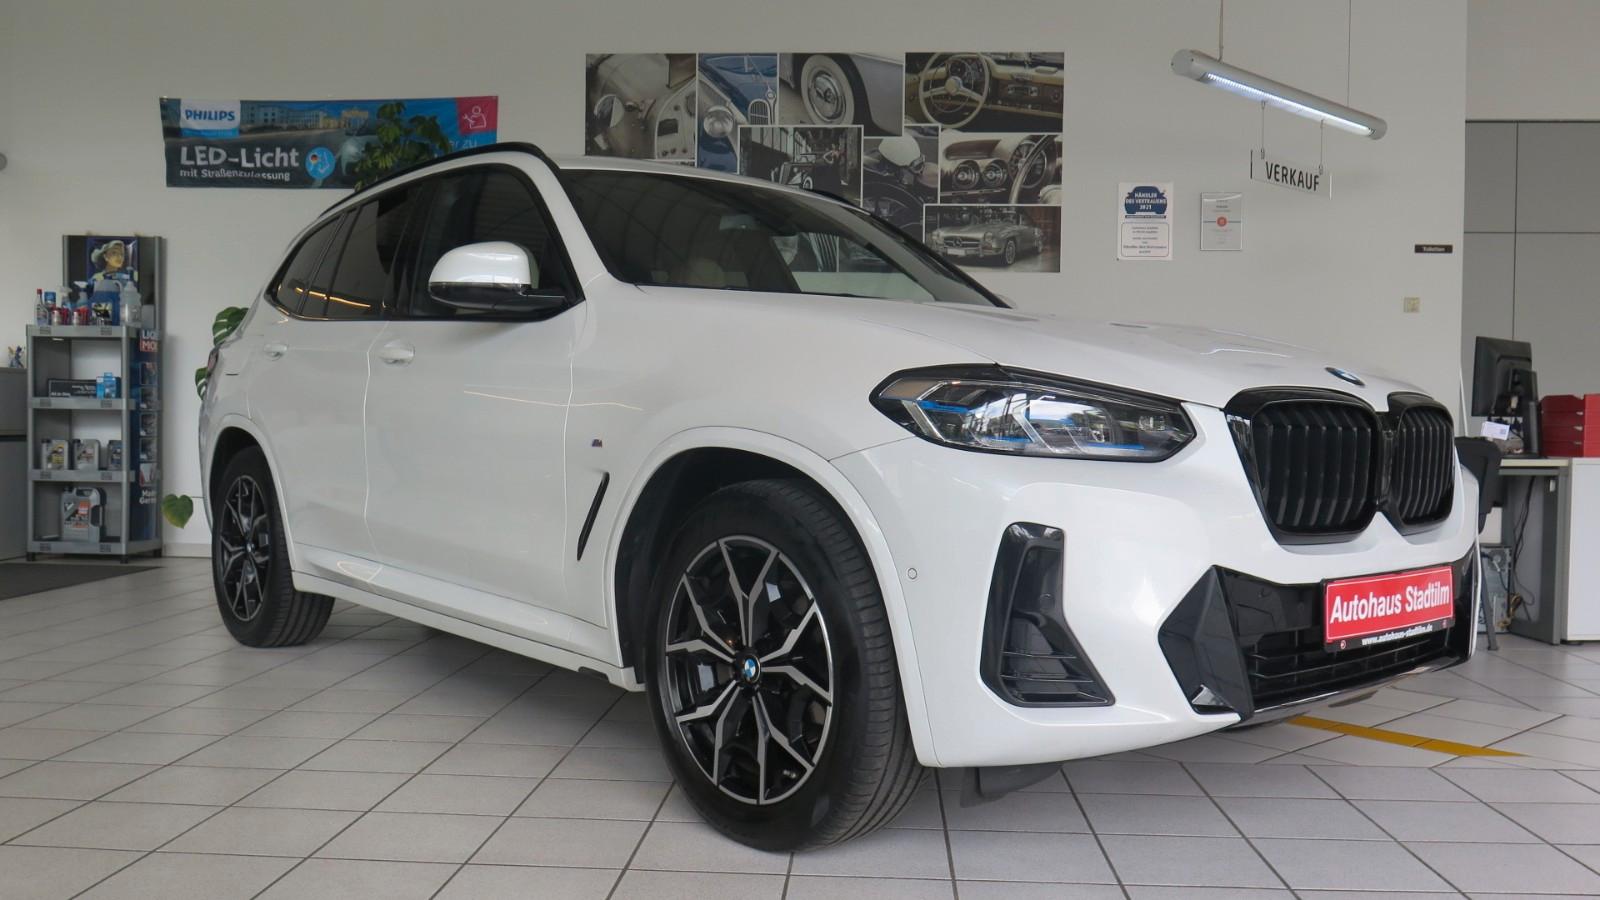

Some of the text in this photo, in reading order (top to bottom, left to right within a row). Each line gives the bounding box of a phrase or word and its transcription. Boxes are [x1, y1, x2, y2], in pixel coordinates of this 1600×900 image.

[184, 109, 236, 121] PHILIPS
[180, 146, 300, 168] LED-Licht
[180, 168, 291, 181] mit Straßenzulassung
[1265, 161, 1320, 192] VERKAUF
[1330, 581, 1450, 624] Autohaus Stadtilm
[1362, 623, 1433, 646] www.autohaus-stadtilm.de
